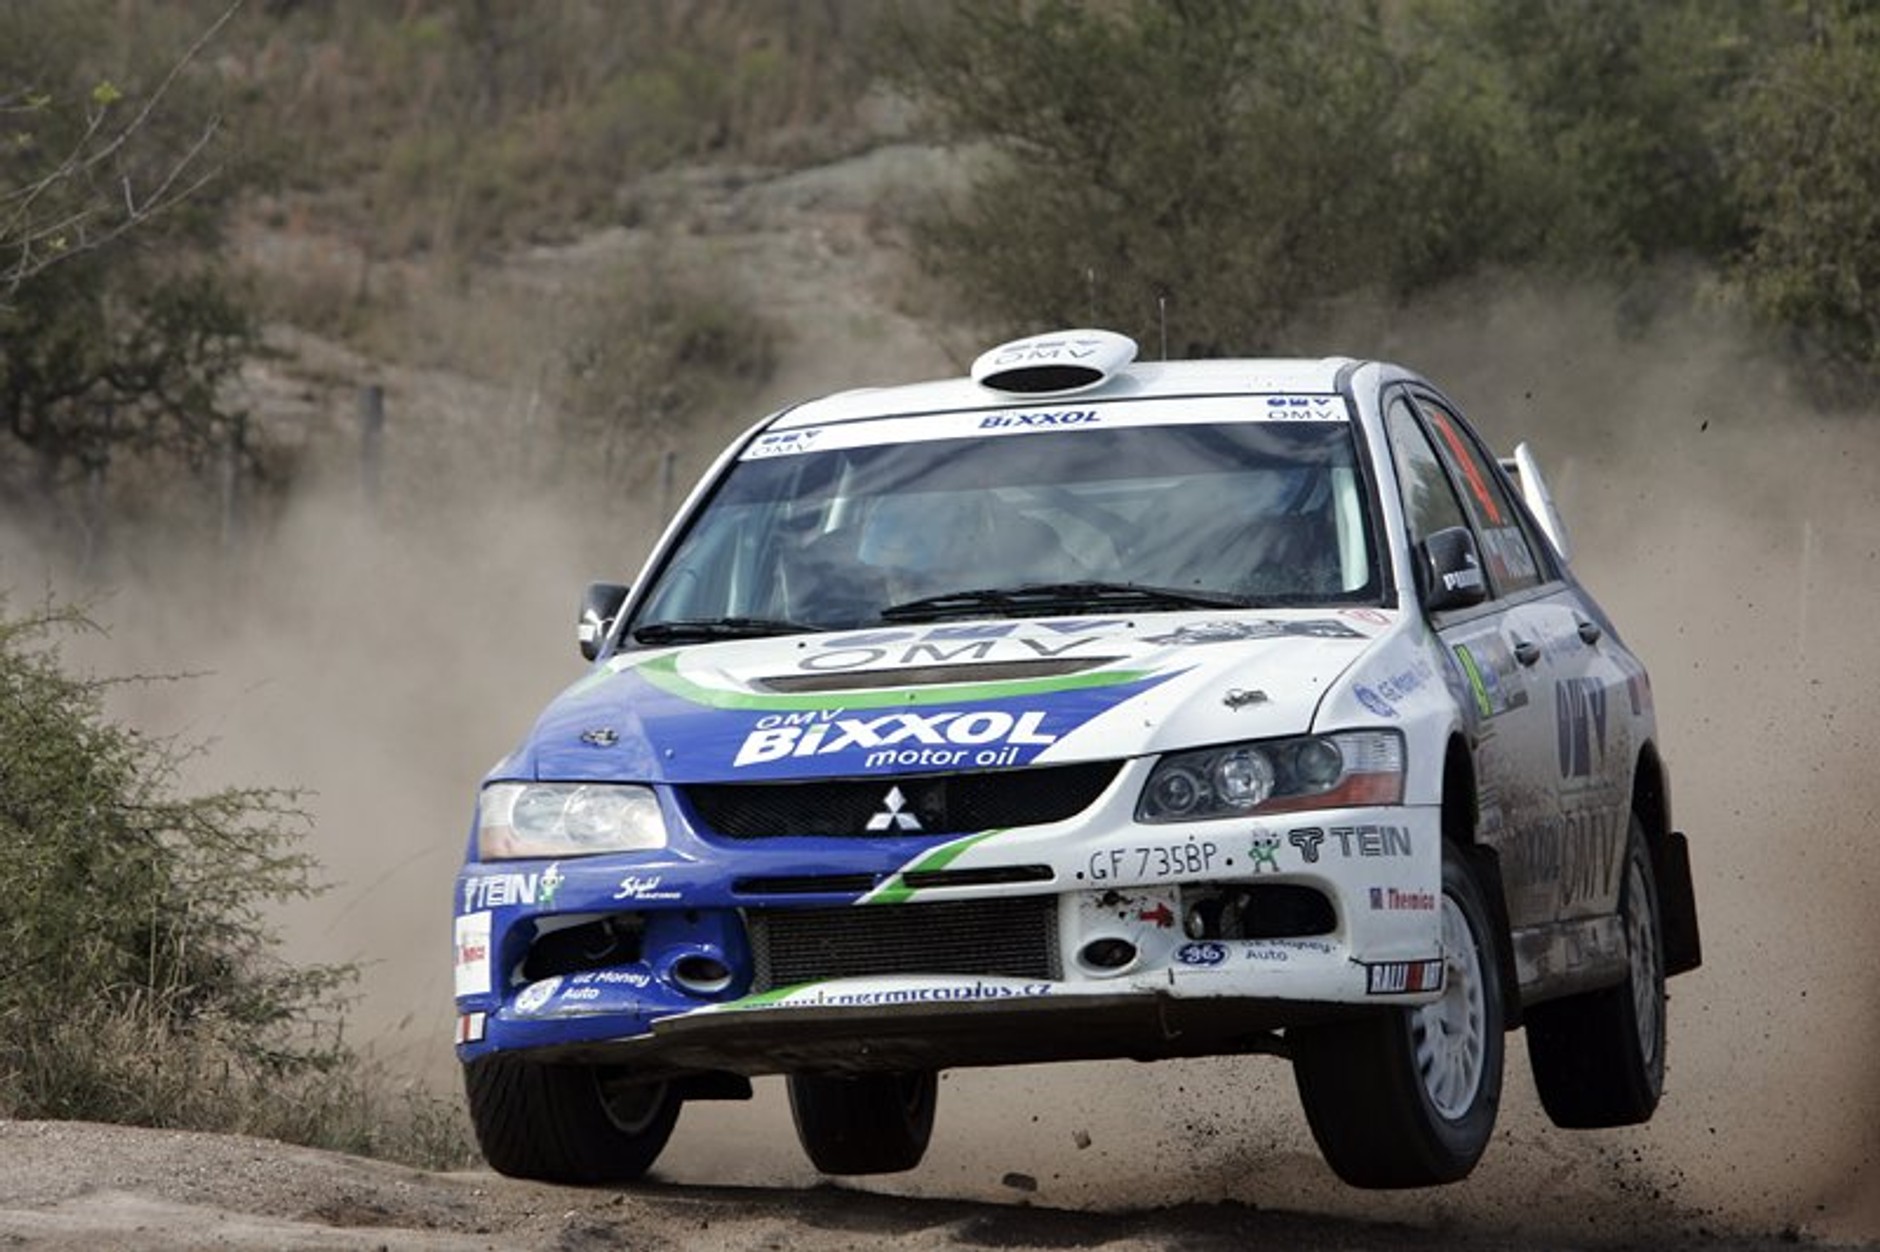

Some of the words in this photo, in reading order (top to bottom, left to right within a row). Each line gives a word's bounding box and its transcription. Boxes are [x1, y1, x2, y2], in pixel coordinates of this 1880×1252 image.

[994, 349, 1096, 365] OMV
[1268, 410, 1333, 420] OMV
[751, 441, 816, 458] OMV
[1443, 568, 1480, 591] PU
[798, 636, 1102, 671] OMV
[756, 707, 845, 730] OMV
[733, 711, 1057, 768] BiXXOL
[865, 749, 969, 768] motor
[975, 747, 1018, 766] oil
[1329, 825, 1412, 857] TEIN
[1246, 949, 1288, 961] Auto
[561, 986, 600, 999] Auto
